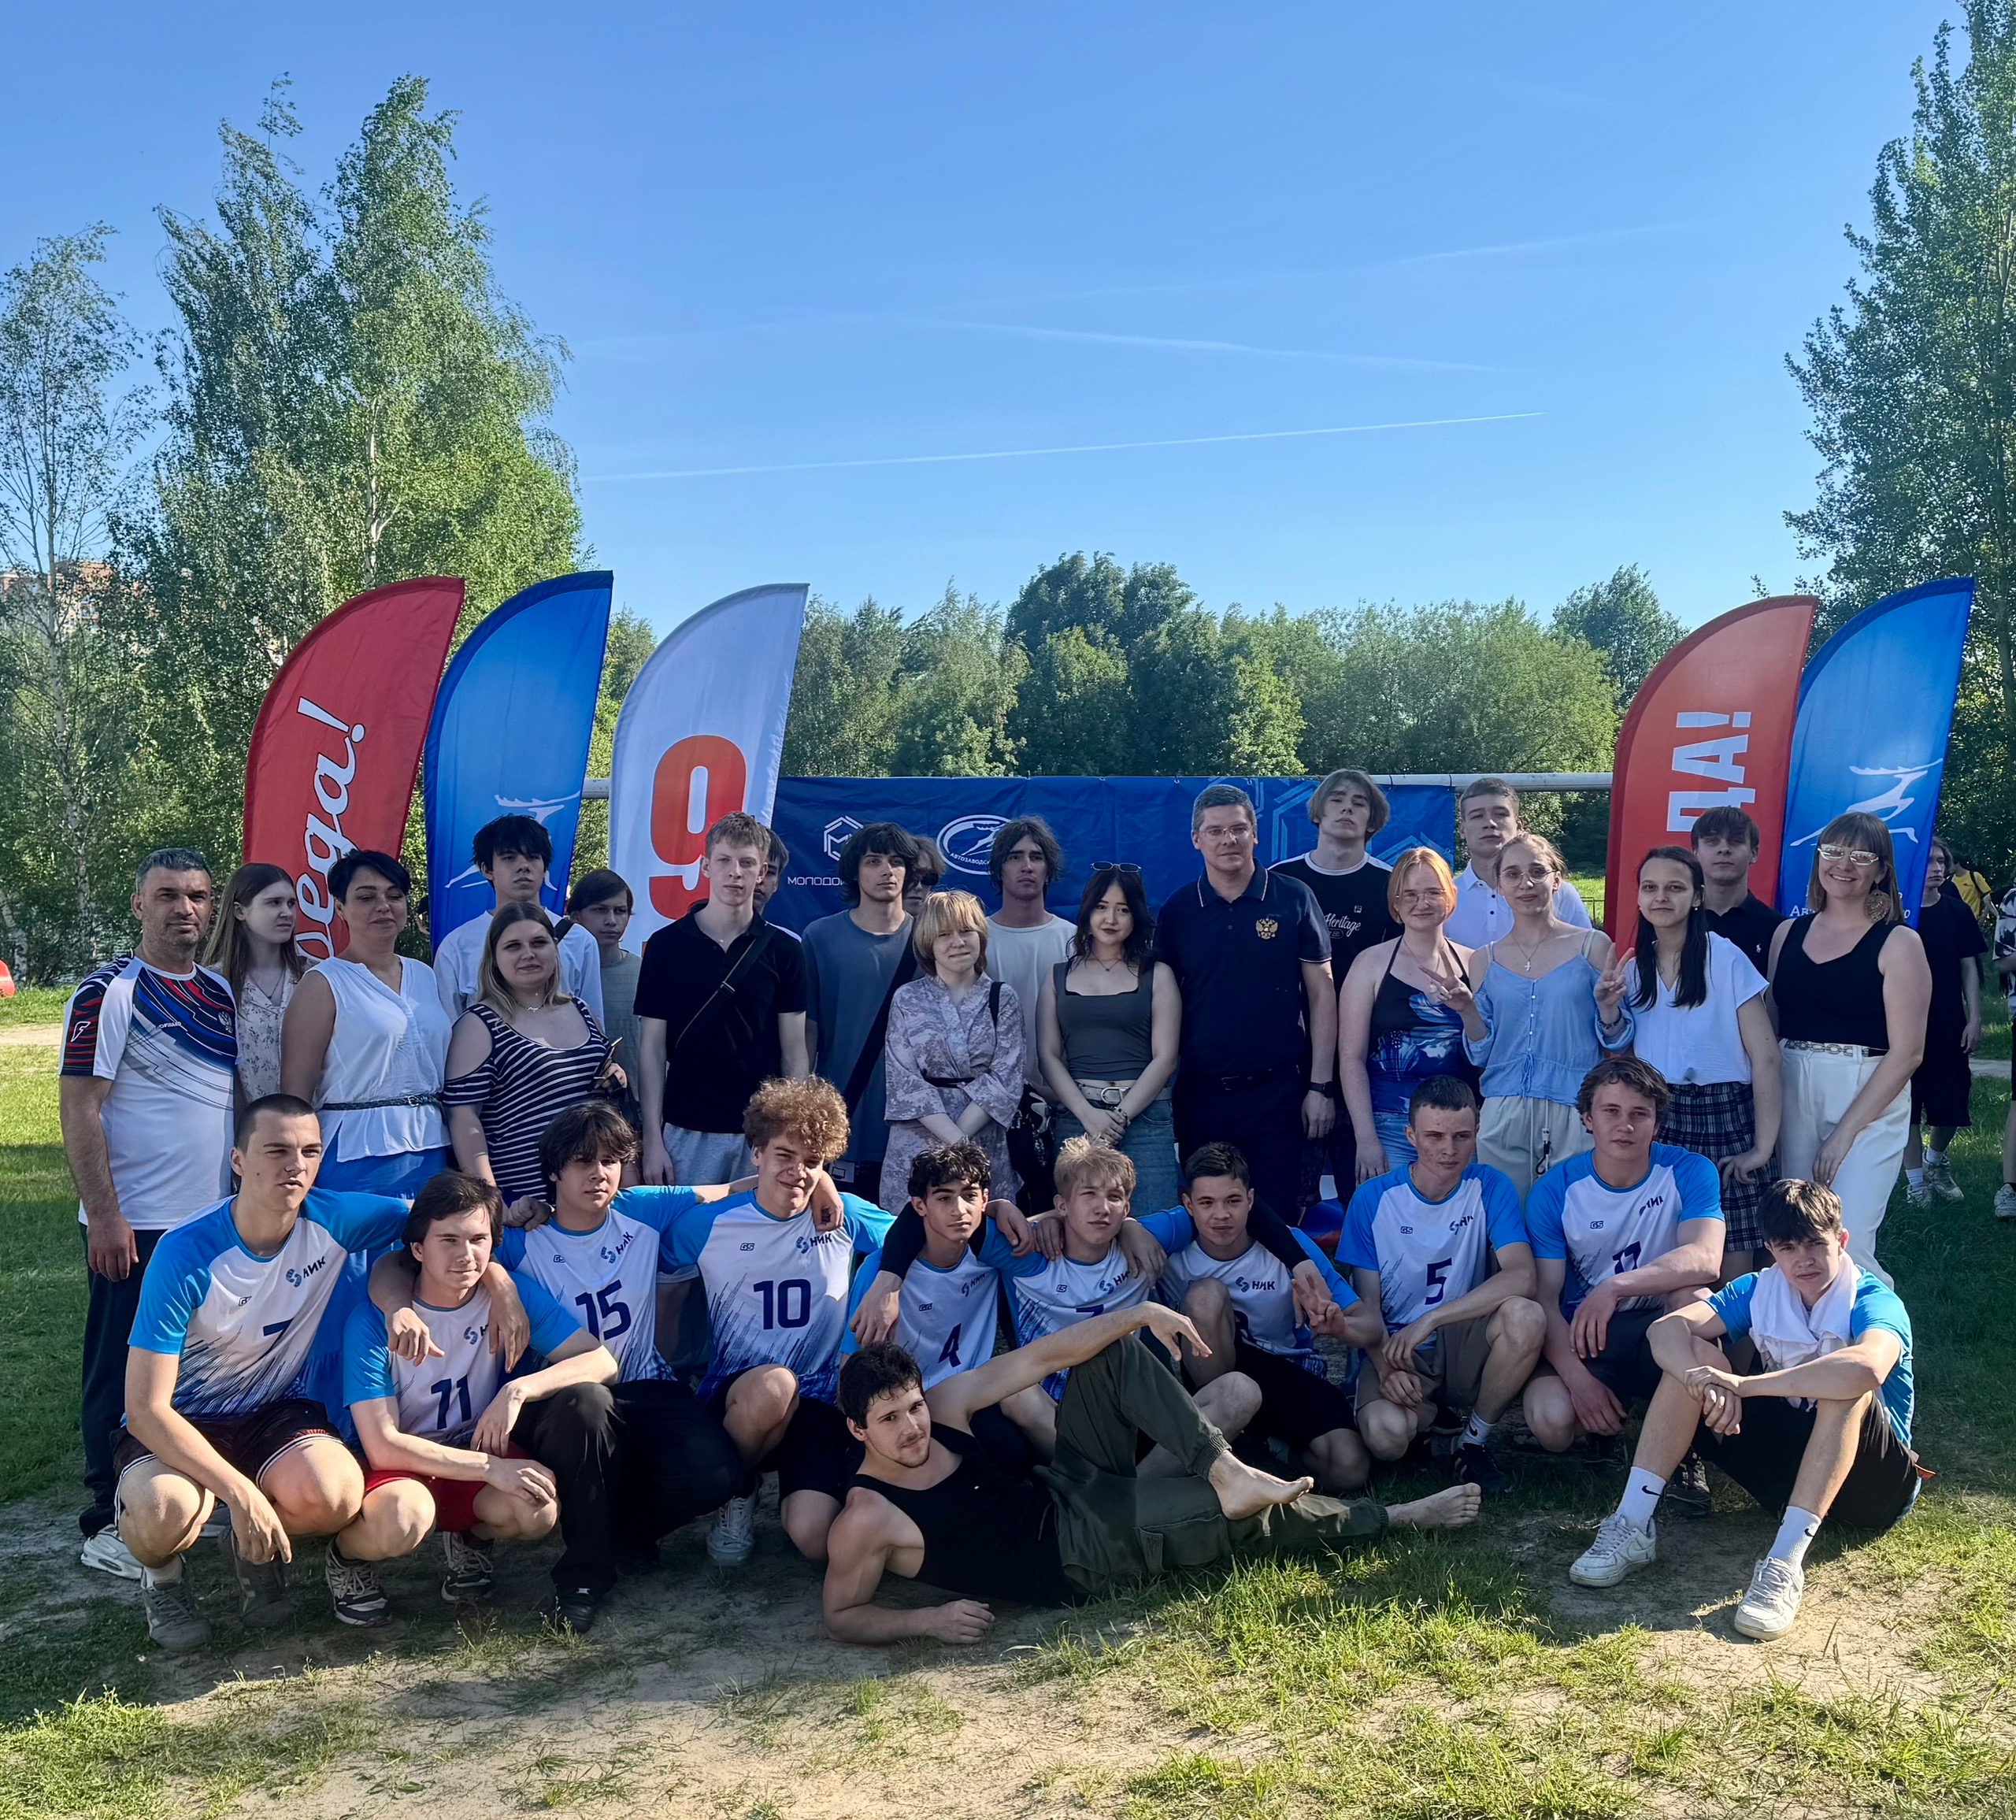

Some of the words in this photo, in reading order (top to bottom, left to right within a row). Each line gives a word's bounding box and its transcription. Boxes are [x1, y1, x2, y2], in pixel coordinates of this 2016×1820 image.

[649, 734, 747, 920] 9
[1325, 912, 1362, 937] Heritage
[810, 1233, 832, 1247] НИК
[1401, 1225, 1414, 1234] GS
[1590, 1221, 1603, 1229] GS
[1114, 1270, 1130, 1286] НИ
[1252, 1281, 1275, 1291] НИК
[1425, 1257, 1452, 1305] 5
[575, 1279, 632, 1342] 15
[753, 1278, 811, 1330] 10
[938, 1322, 962, 1367] 4
[431, 1373, 472, 1430] 11
